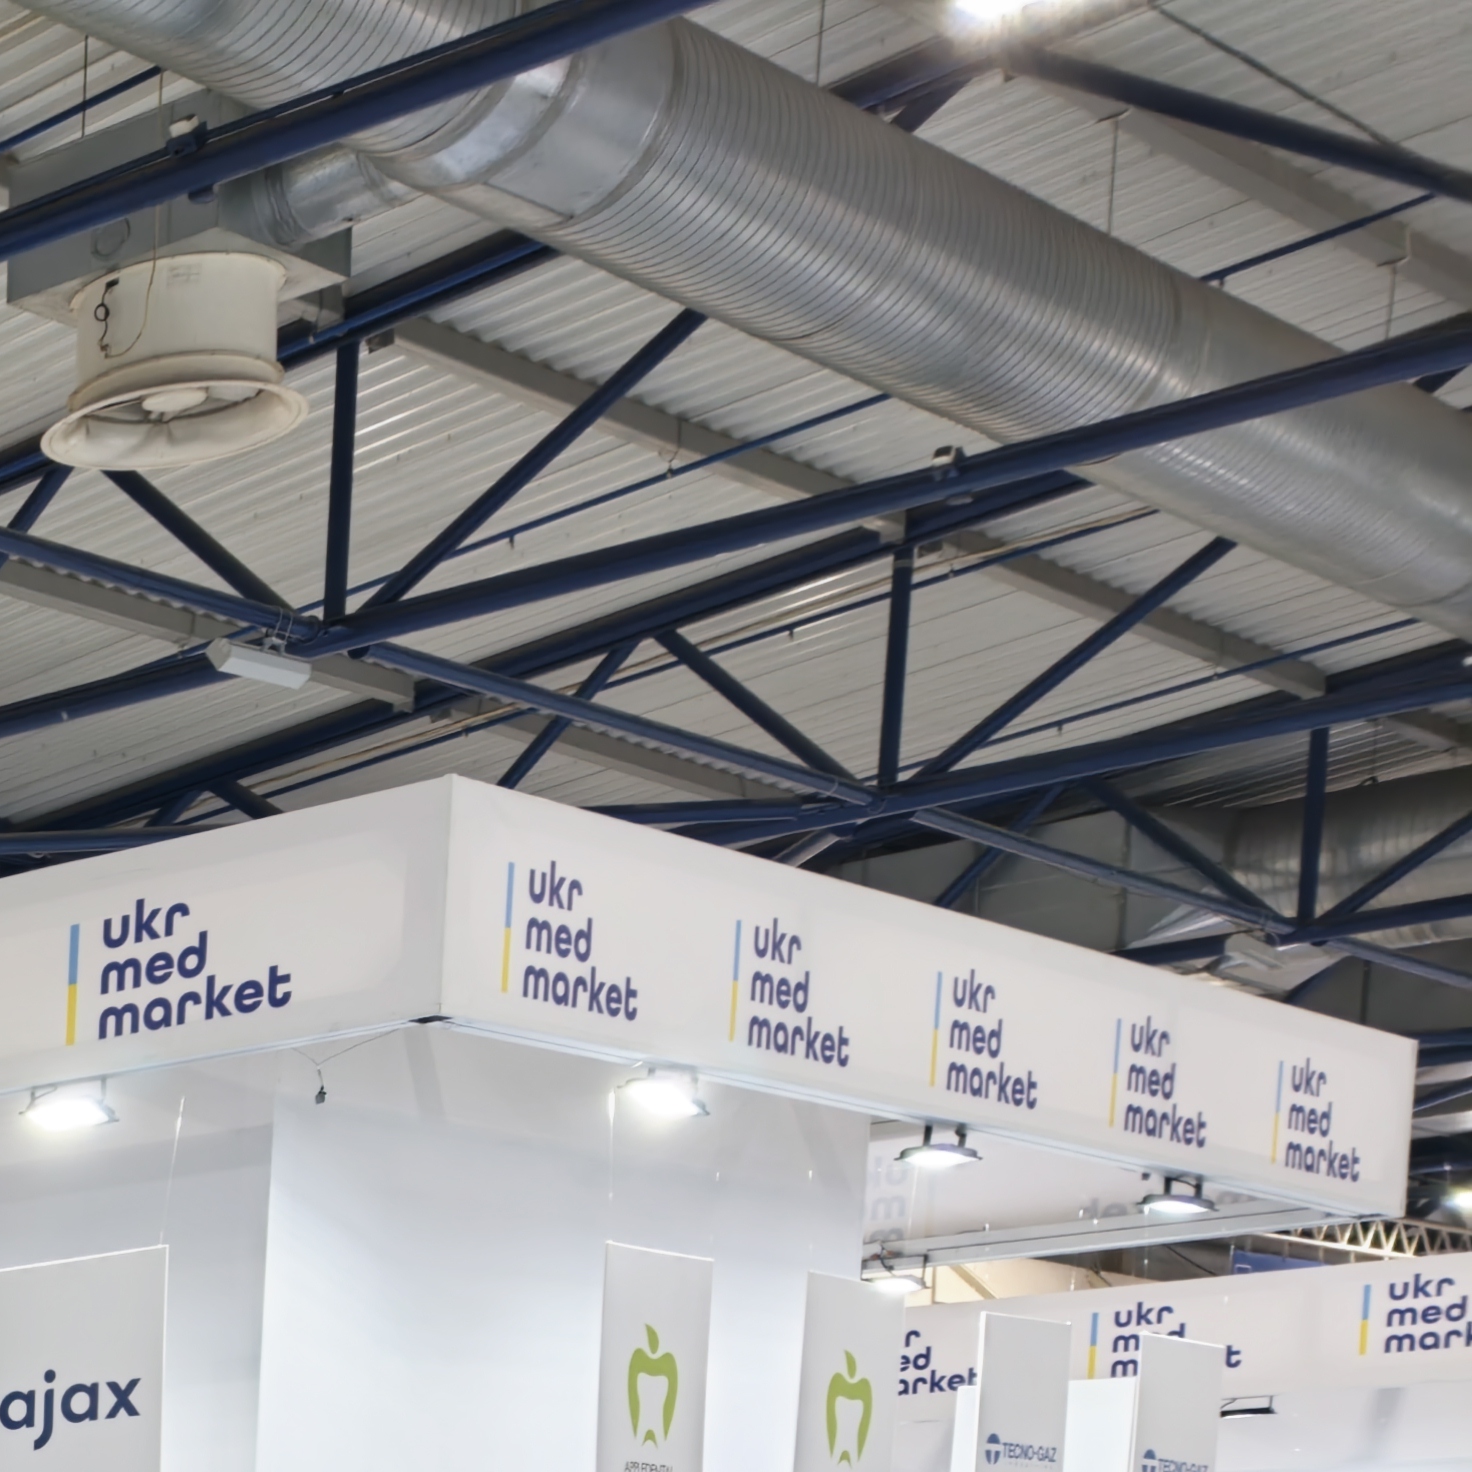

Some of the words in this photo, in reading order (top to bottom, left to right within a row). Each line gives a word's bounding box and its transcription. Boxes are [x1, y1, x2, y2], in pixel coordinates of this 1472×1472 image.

[529, 861, 582, 911] ukr
[103, 899, 190, 948] ukr
[526, 917, 592, 962] med
[754, 918, 801, 964] ukr
[101, 931, 207, 994] med
[99, 965, 291, 1039] market
[523, 965, 637, 1021] market
[751, 971, 809, 1013] med
[953, 969, 995, 1013] ukr
[748, 1016, 849, 1067] market
[950, 1019, 1002, 1058] med
[1131, 1016, 1170, 1057] ukr
[946, 1062, 1037, 1109] market
[1127, 1063, 1176, 1100] med
[1292, 1058, 1326, 1097] ukr
[1124, 1104, 1206, 1148] market
[1288, 1102, 1332, 1137] med
[1285, 1141, 1360, 1182] market
[1389, 1273, 1455, 1301] ukr
[1114, 1302, 1174, 1328] ukr
[1387, 1295, 1468, 1327] med
[900, 1346, 931, 1372] ed
[0, 1370, 140, 1450] ajax
[1002, 1442, 1057, 1463] TECNO-GAZ
